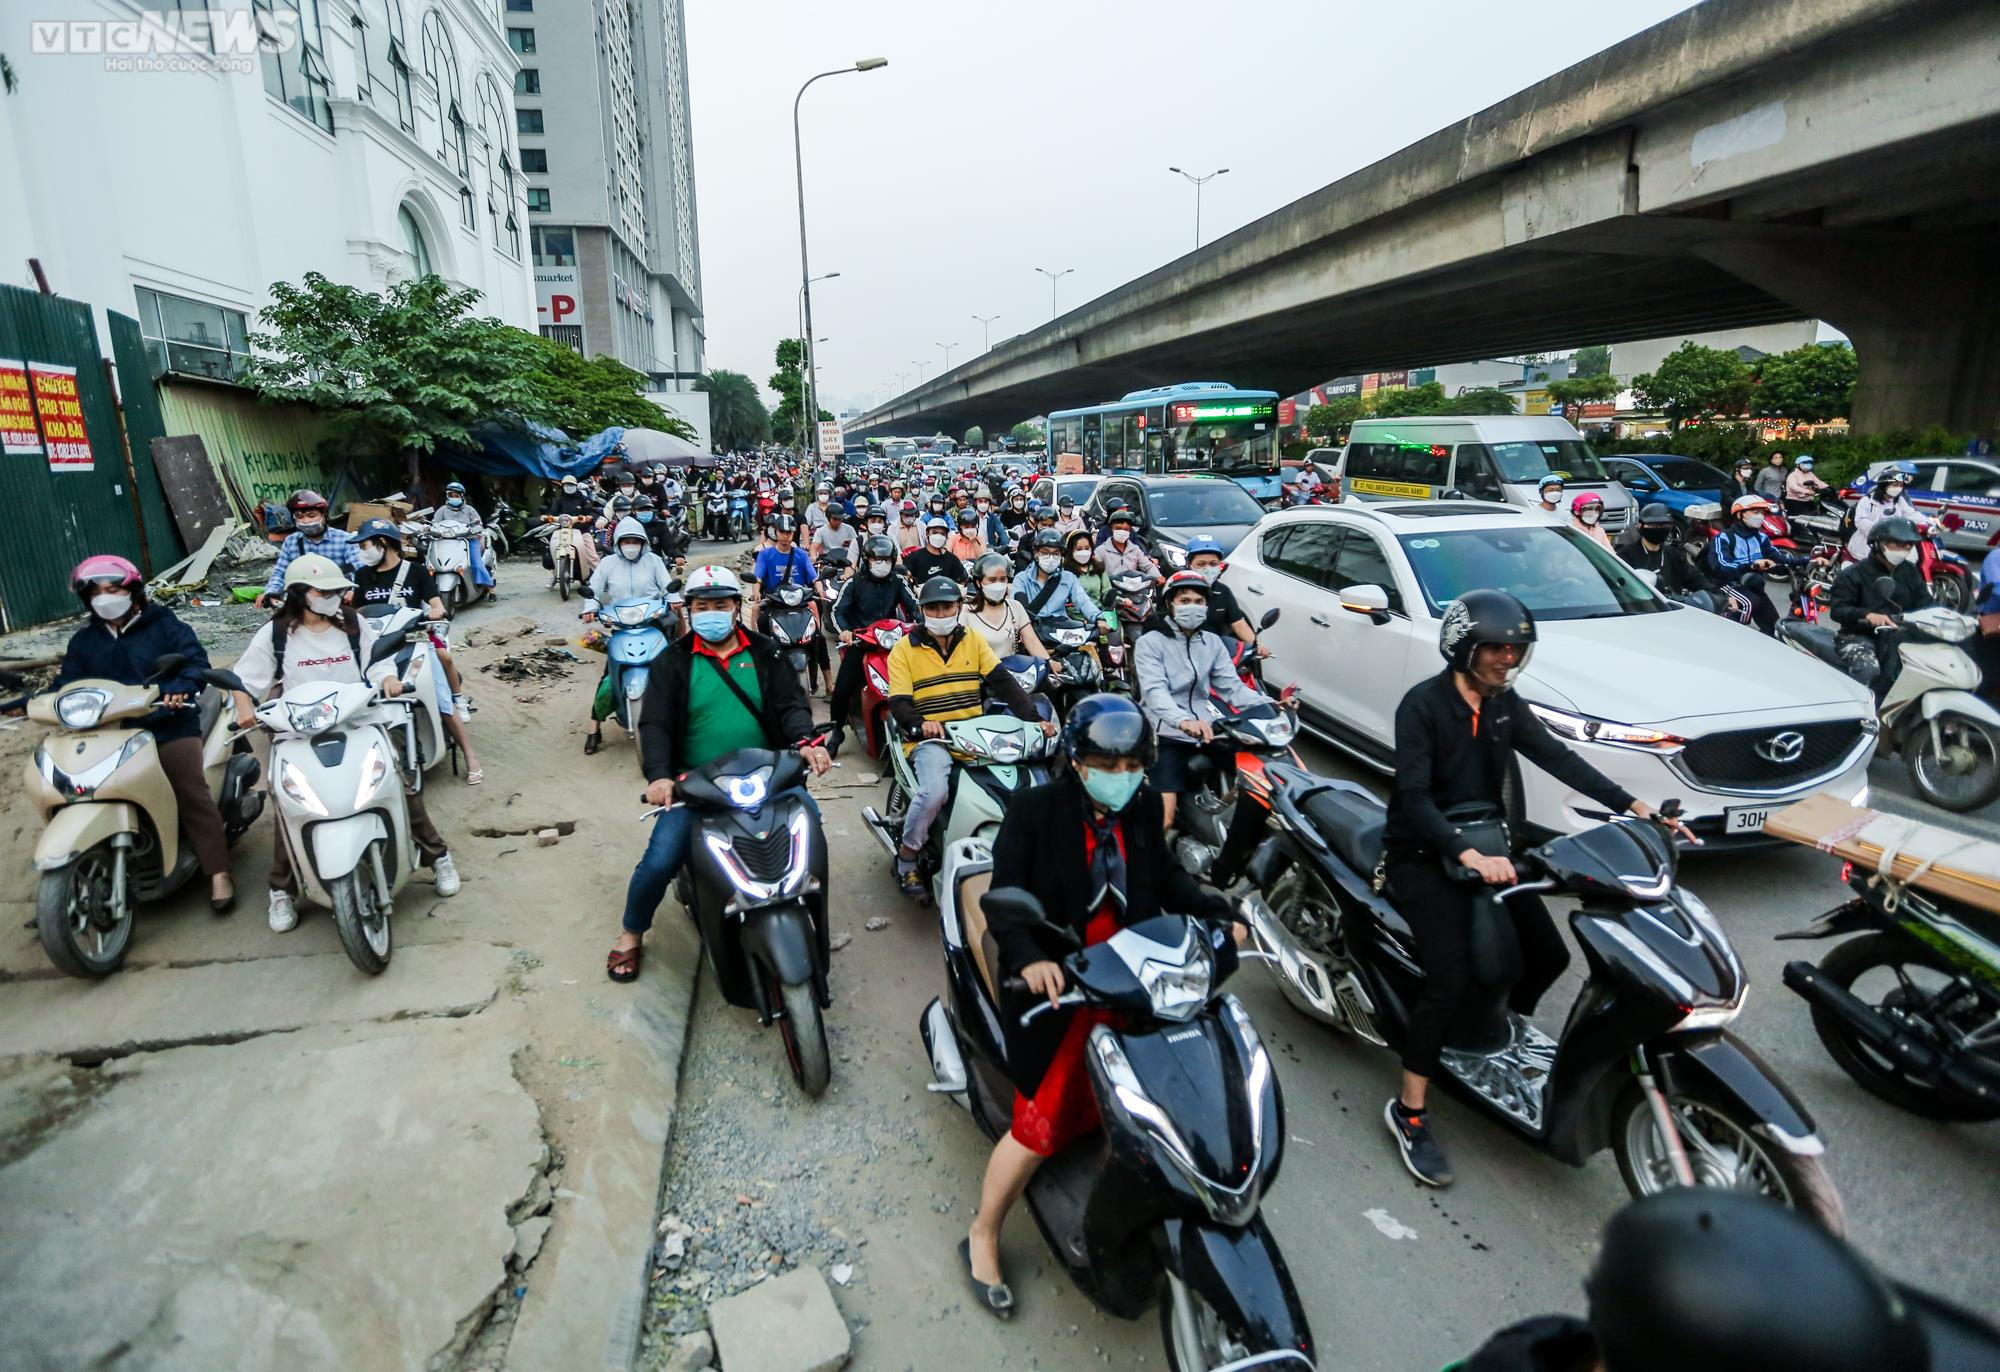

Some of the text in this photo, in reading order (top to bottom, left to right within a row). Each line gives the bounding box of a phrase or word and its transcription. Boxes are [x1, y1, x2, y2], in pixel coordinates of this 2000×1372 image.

[46, 421, 66, 438] KHO
[1964, 520, 1988, 530] TAXI
[1168, 1029, 1202, 1043] HONDA
